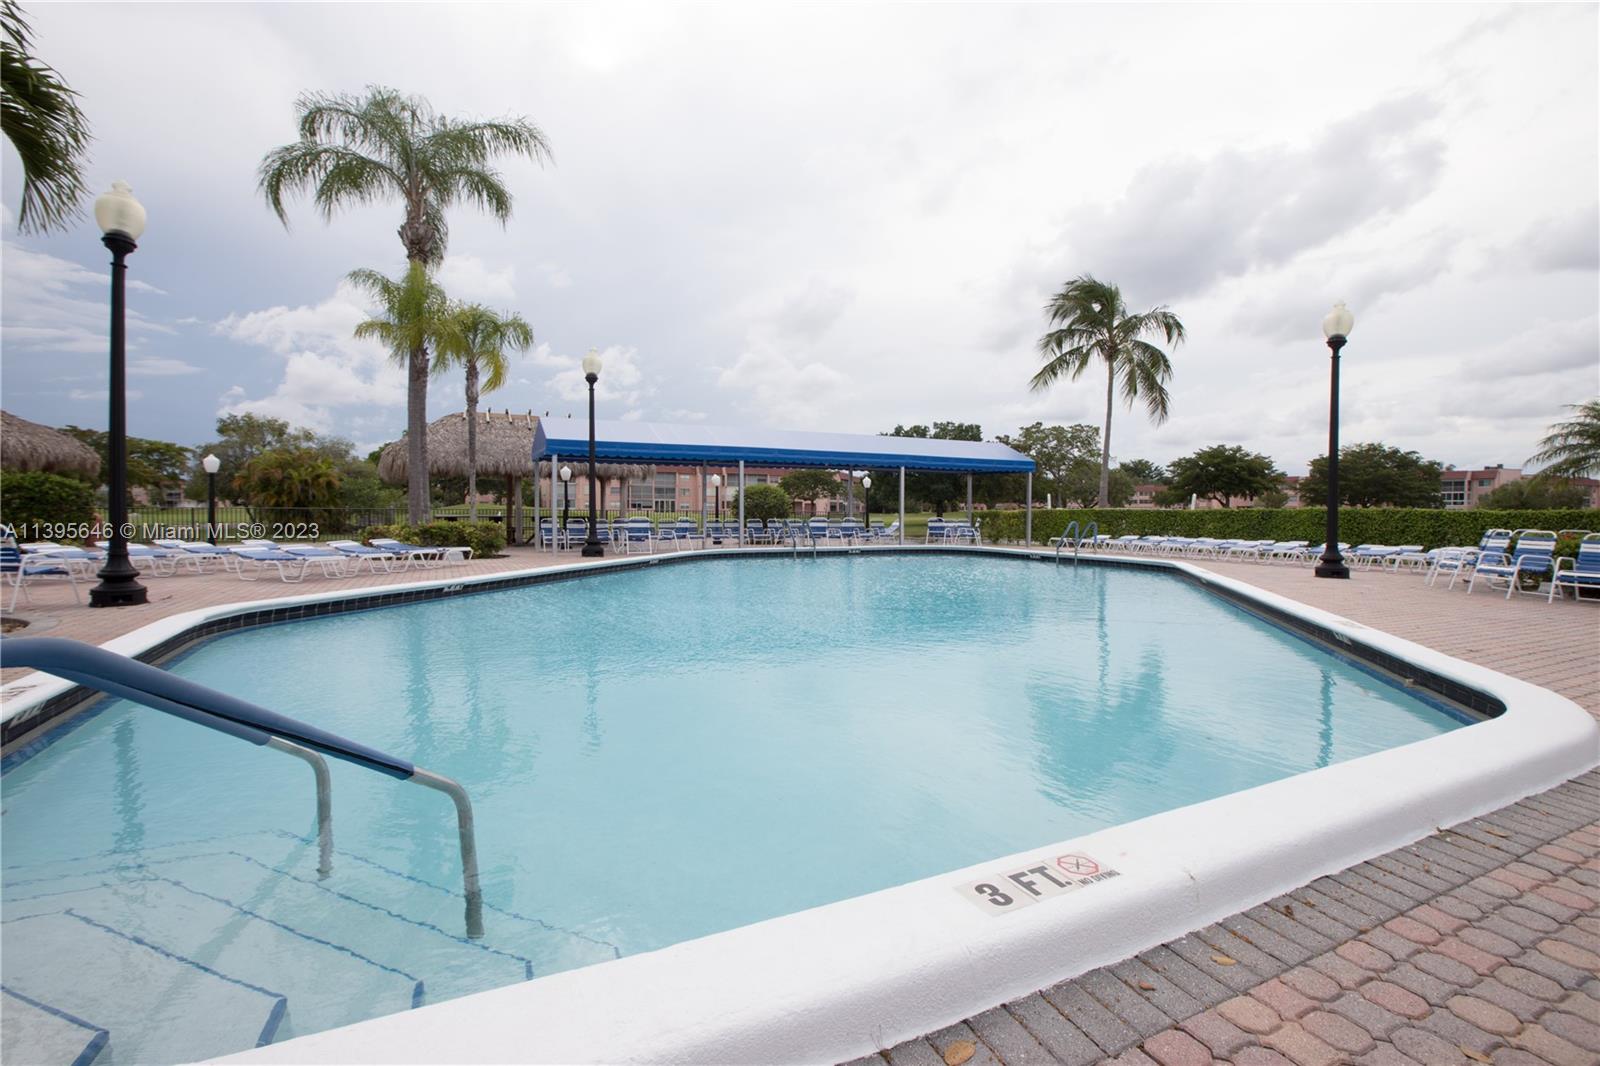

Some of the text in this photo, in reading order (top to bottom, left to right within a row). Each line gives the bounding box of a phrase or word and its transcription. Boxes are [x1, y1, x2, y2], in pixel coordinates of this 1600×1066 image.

[974, 865, 1073, 907] 3 FT.
[1078, 869, 1121, 887] NO DIVING
